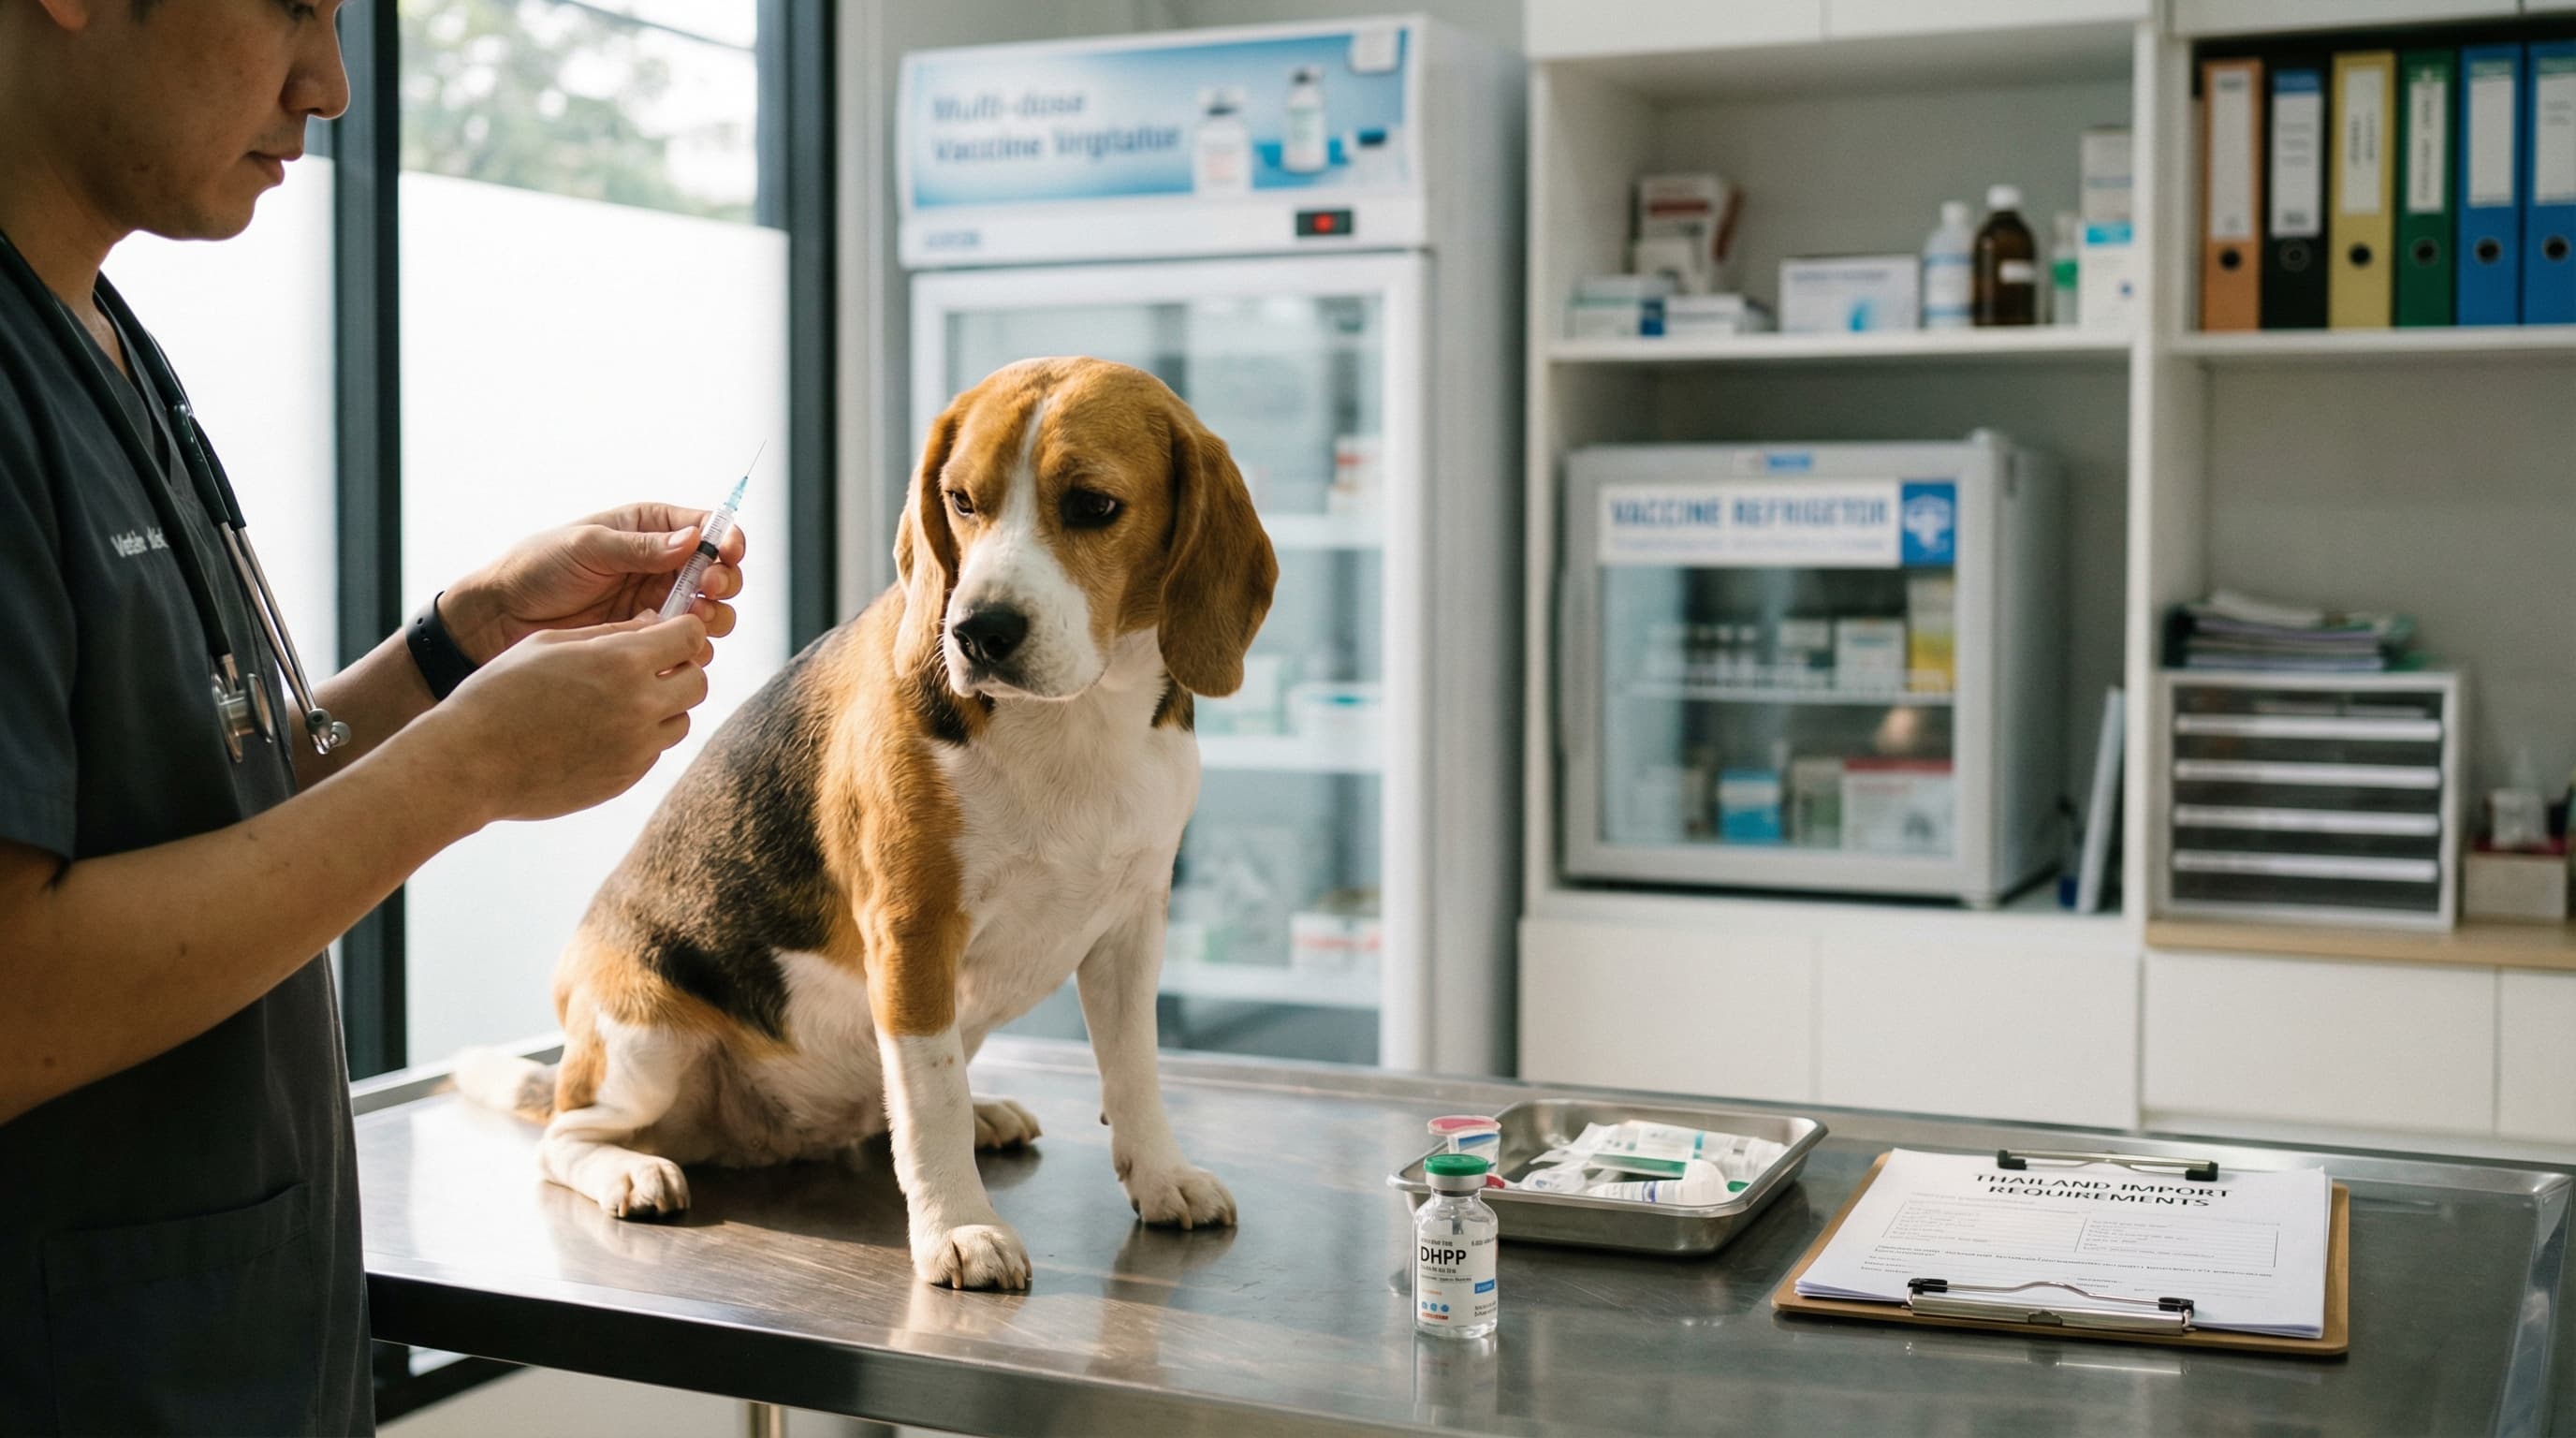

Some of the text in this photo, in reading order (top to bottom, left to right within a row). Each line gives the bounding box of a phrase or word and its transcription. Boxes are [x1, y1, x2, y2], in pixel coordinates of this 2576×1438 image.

[1613, 498, 1720, 527] VACCINE
[1975, 1174, 2233, 1198] THAILAND IMPORT
[1988, 1185, 2211, 1207] REQUIREMENTS
[1421, 1246, 1467, 1265] DHPP
